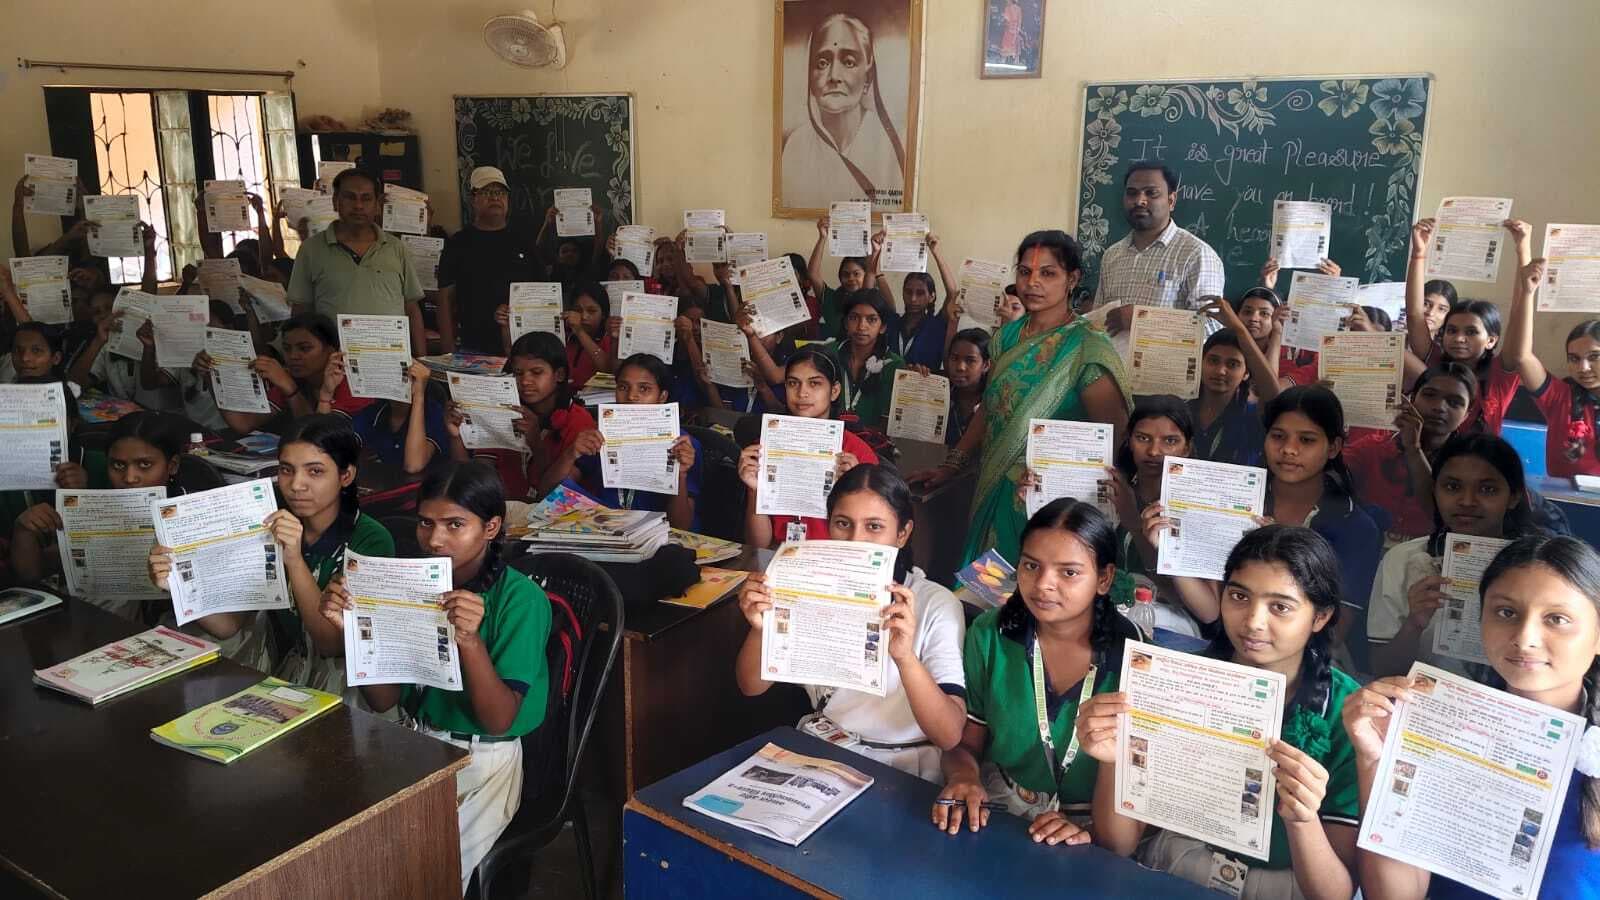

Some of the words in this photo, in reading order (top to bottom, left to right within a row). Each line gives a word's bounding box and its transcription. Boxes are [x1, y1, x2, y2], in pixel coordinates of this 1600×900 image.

[1129, 135, 1168, 161] It
[1185, 142, 1211, 162] is
[1214, 139, 1273, 186] great
[1176, 173, 1216, 201] have
[1226, 186, 1264, 223] you
